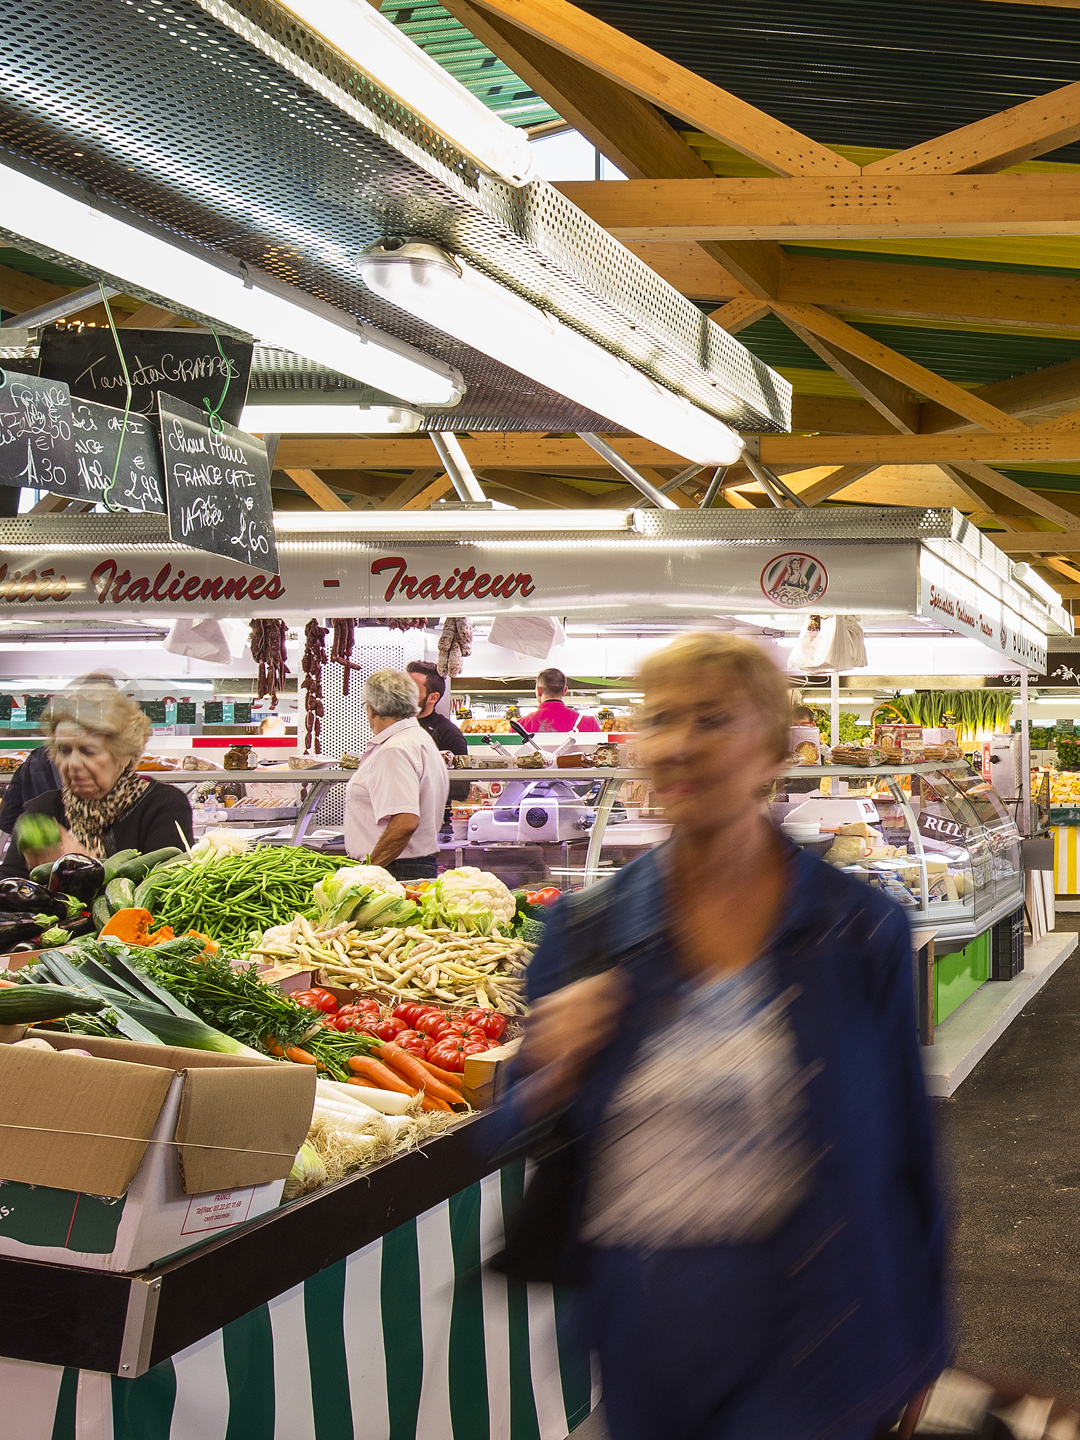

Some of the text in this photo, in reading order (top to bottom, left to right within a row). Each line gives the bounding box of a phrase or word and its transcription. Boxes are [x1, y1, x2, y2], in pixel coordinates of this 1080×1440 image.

[74, 438, 104, 455] NCE
[173, 463, 223, 488] FRANCE
[90, 559, 286, 604] Italiennes
[371, 556, 536, 602] Traiteur
